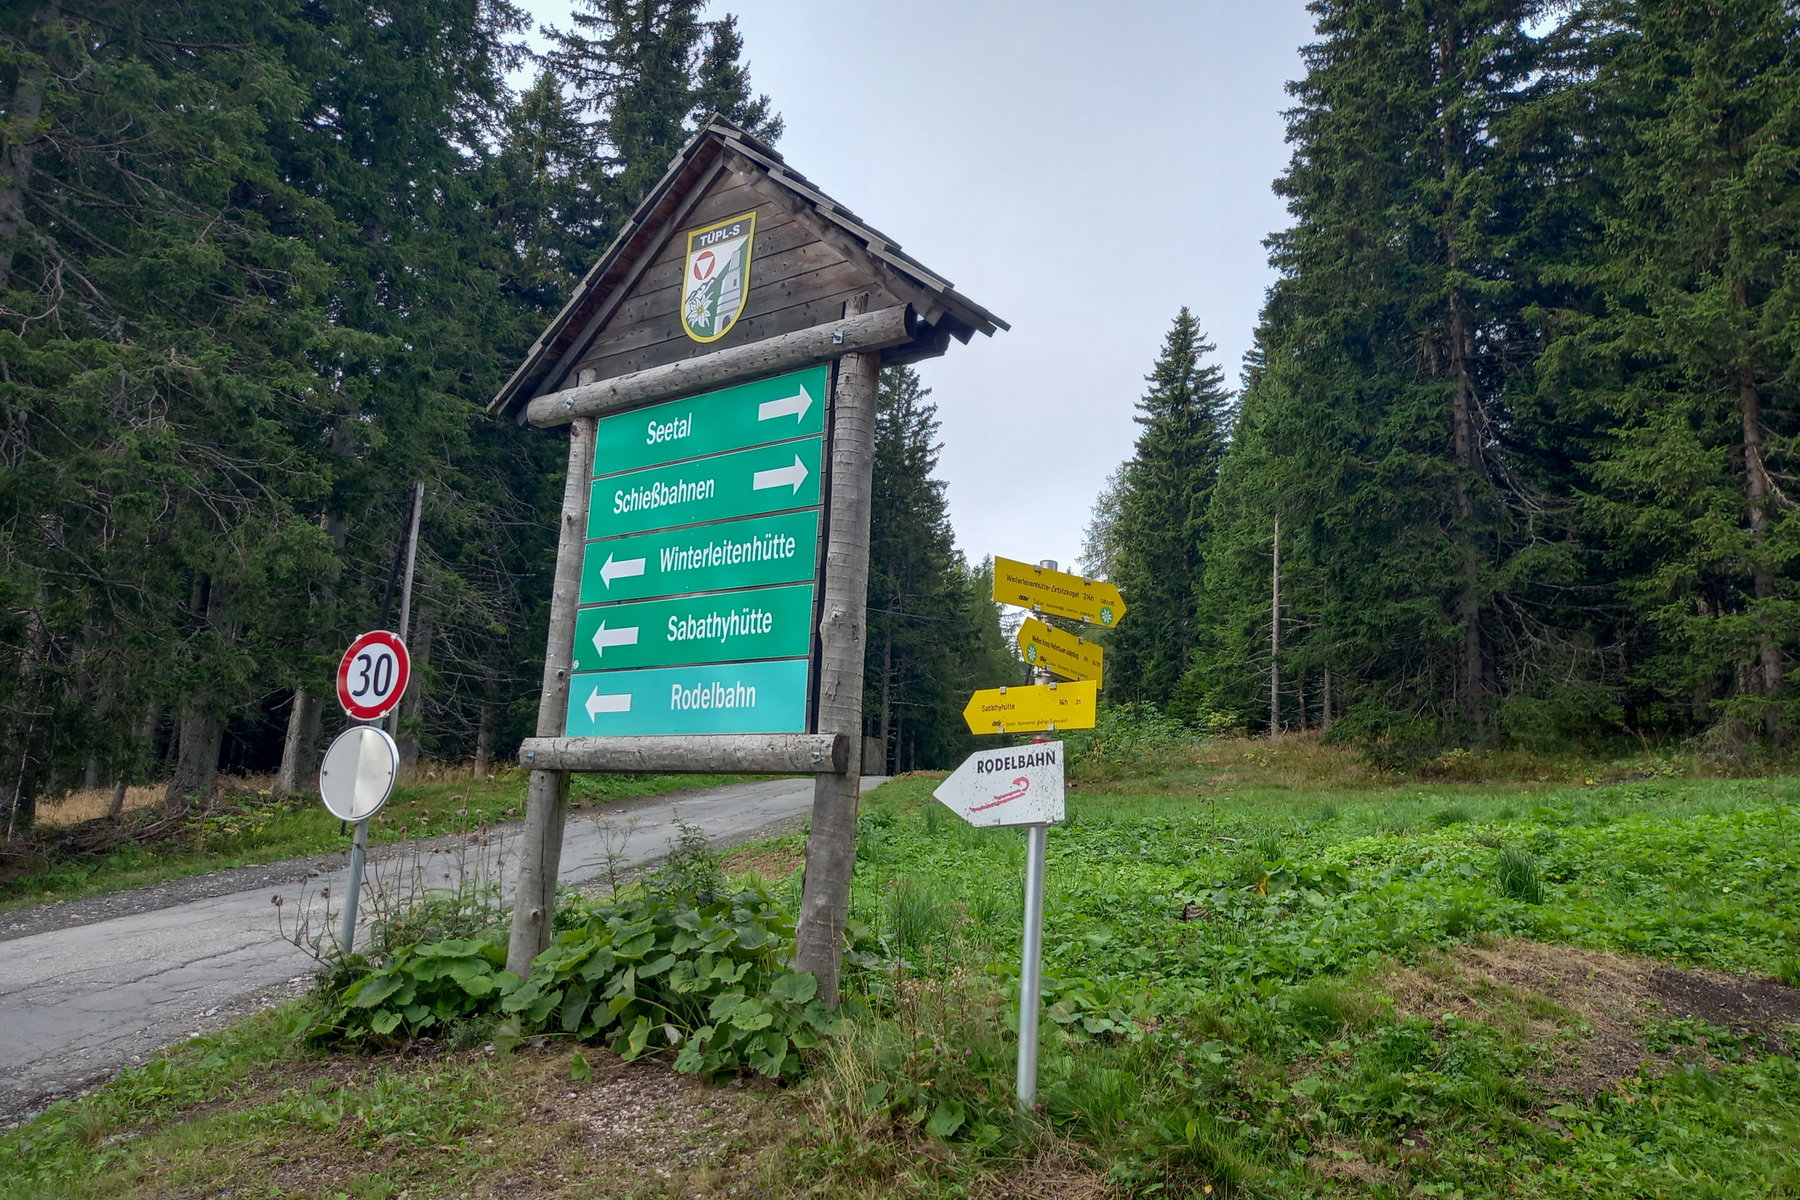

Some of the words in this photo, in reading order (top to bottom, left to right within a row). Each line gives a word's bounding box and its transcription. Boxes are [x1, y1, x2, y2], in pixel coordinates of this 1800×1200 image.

[700, 223, 741, 246] TÜPL-S
[646, 413, 692, 445] Seetal
[613, 478, 715, 514] Schießbahnen
[659, 533, 795, 572] Winterleitenhütte
[667, 608, 773, 643] Sabathyhütte
[352, 653, 392, 697] 30
[671, 681, 756, 711] Rodelbahn
[977, 751, 1056, 774] RODELBAHN
